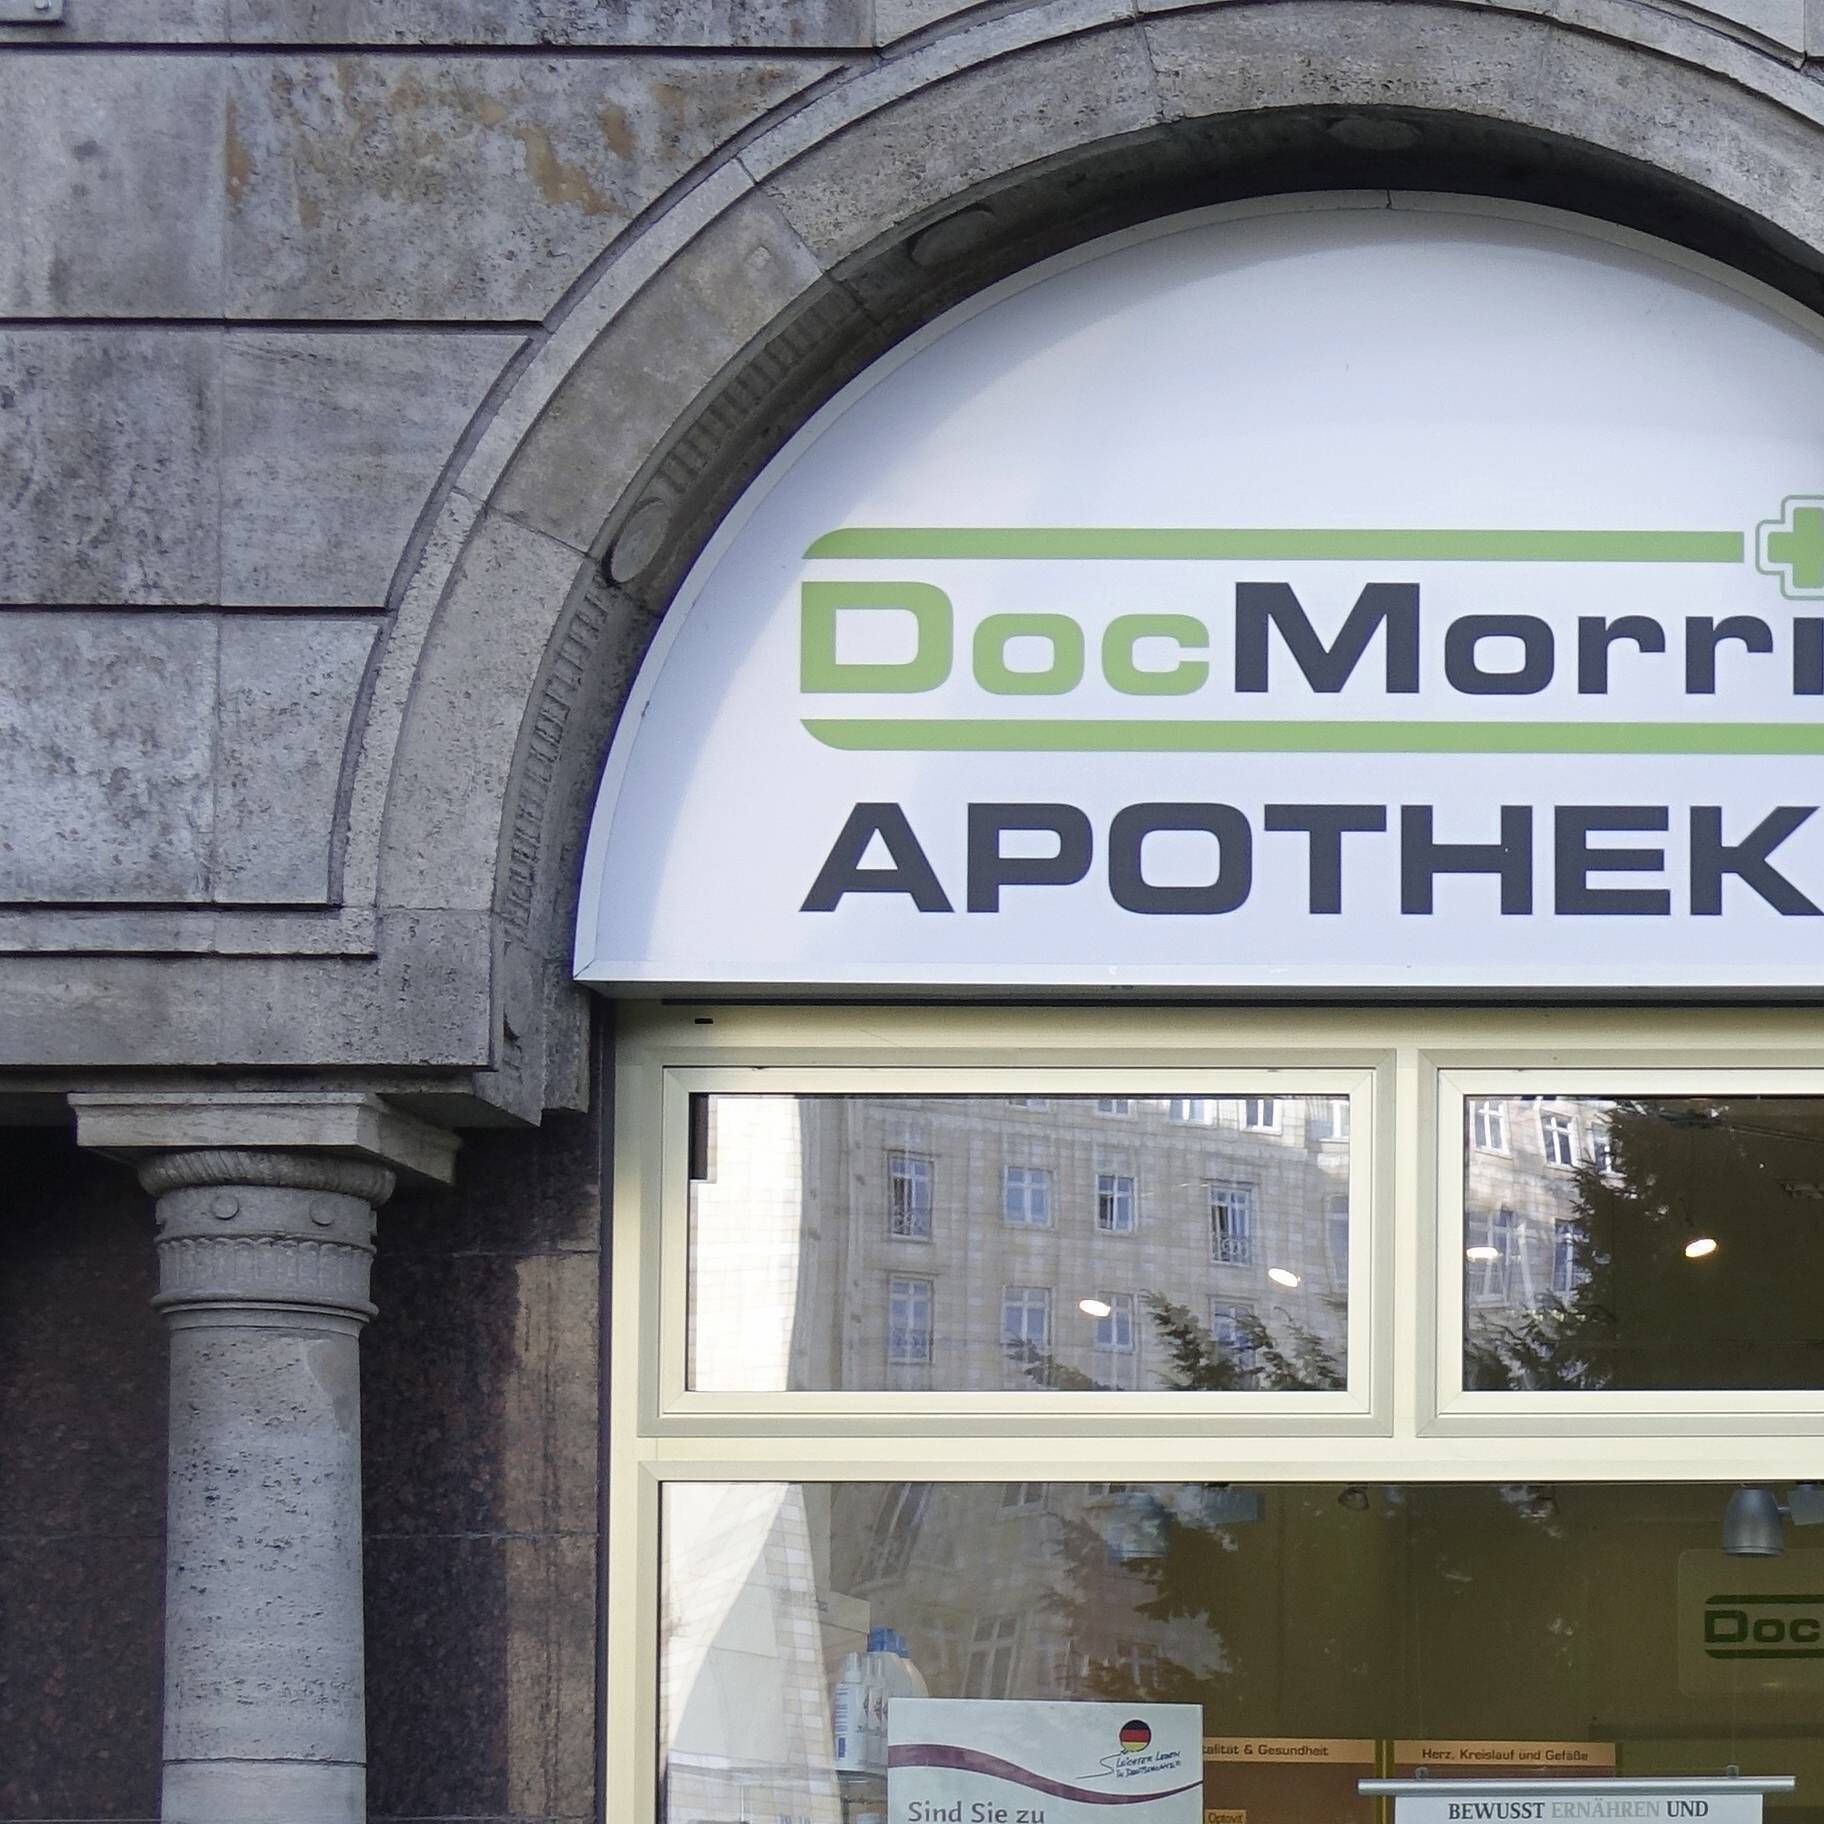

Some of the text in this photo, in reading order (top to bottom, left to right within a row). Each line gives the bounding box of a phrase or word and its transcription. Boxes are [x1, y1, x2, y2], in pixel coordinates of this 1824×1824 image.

[1243, 1744, 1253, 1755] &
[1258, 1744, 1329, 1756] Gesundheit
[1460, 1748, 1514, 1761] Kreislauf
[1518, 1749, 1541, 1761] und
[1545, 1749, 1588, 1761] Gefäße
[907, 1801, 1045, 1824] Sind Sie zu
[1448, 1797, 1709, 1820] BEWUSST ERNÄHREN UND
